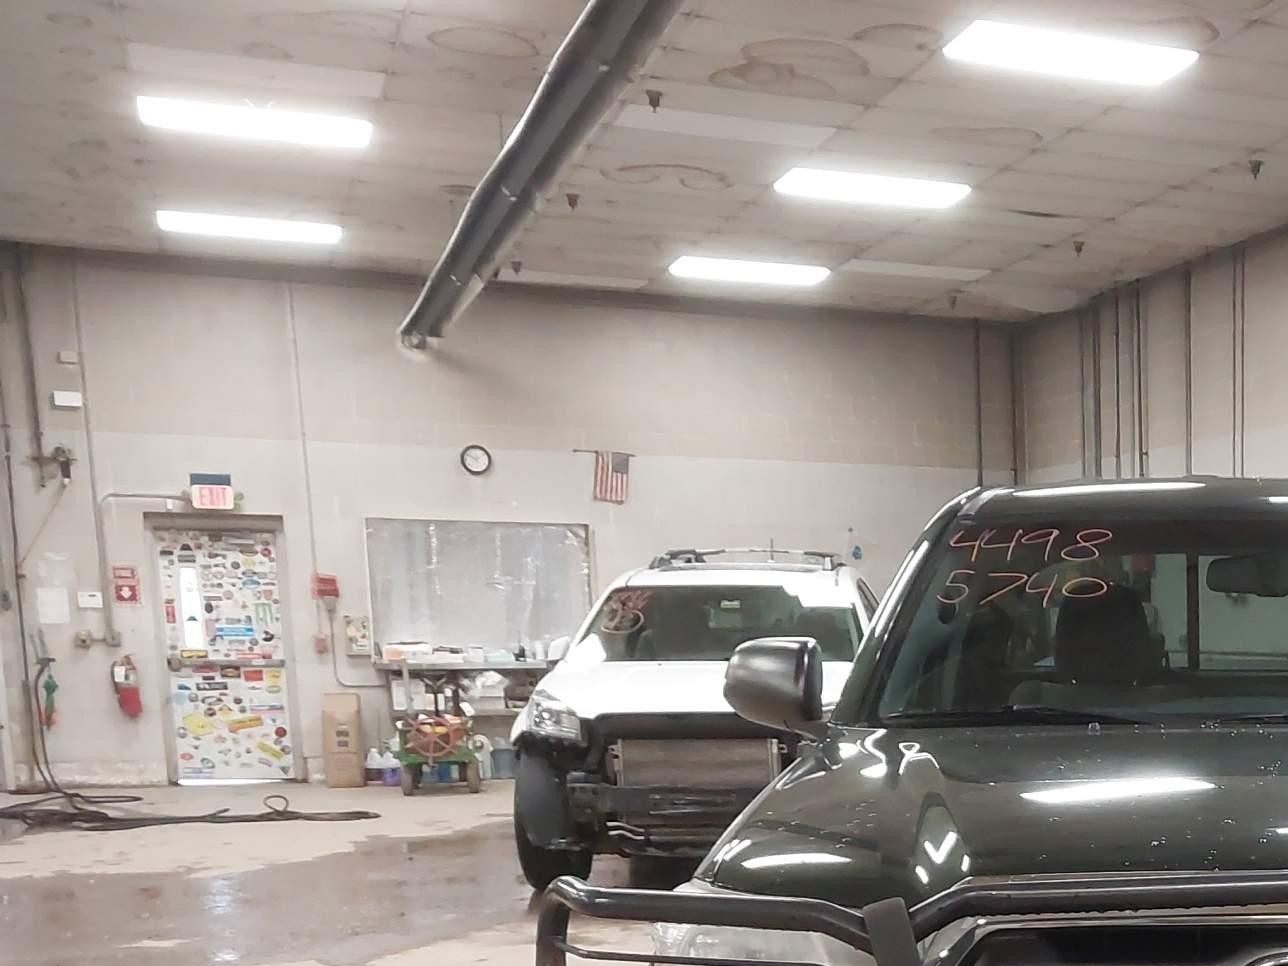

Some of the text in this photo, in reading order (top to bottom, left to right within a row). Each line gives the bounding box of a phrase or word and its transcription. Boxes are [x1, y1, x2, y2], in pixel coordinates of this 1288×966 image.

[198, 487, 227, 507] EXIT
[950, 529, 1112, 562] 4498
[936, 570, 1108, 608] 5740
